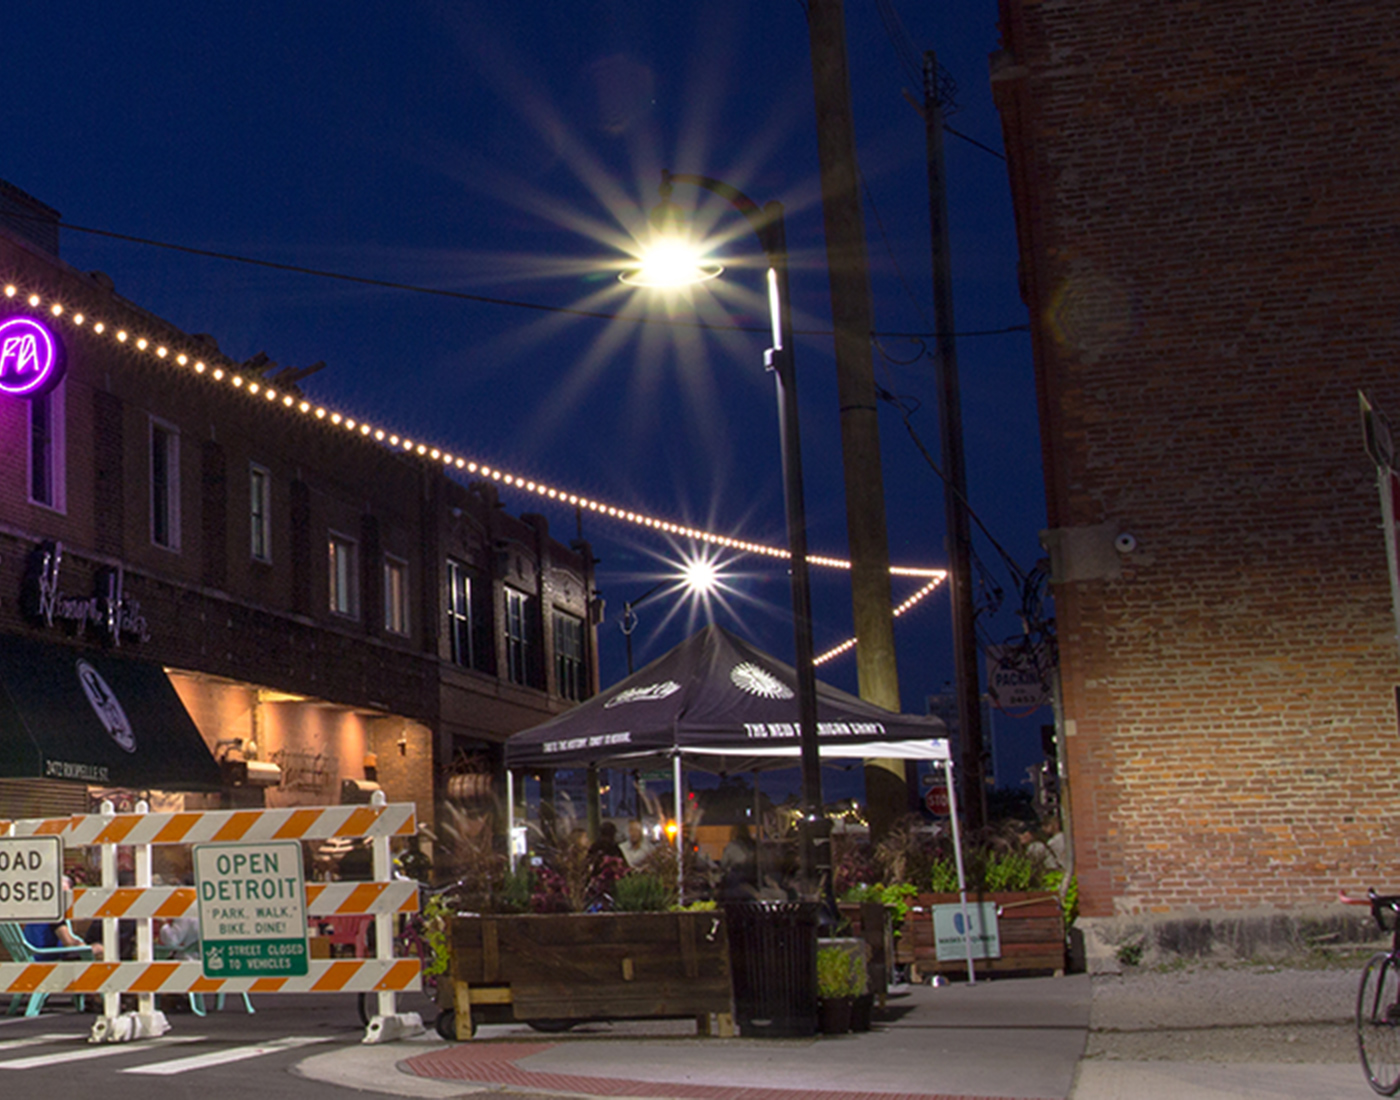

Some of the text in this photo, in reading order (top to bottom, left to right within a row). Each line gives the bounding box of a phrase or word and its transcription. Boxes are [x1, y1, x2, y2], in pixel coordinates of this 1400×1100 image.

[743, 722, 768, 738] THE
[766, 722, 795, 737] NEW
[928, 794, 950, 807] STO
[216, 852, 279, 875] OPEN
[202, 878, 297, 901] DETROIT
[228, 943, 304, 956] STREET CLOSED
[229, 957, 291, 969] TO VEHICLES
